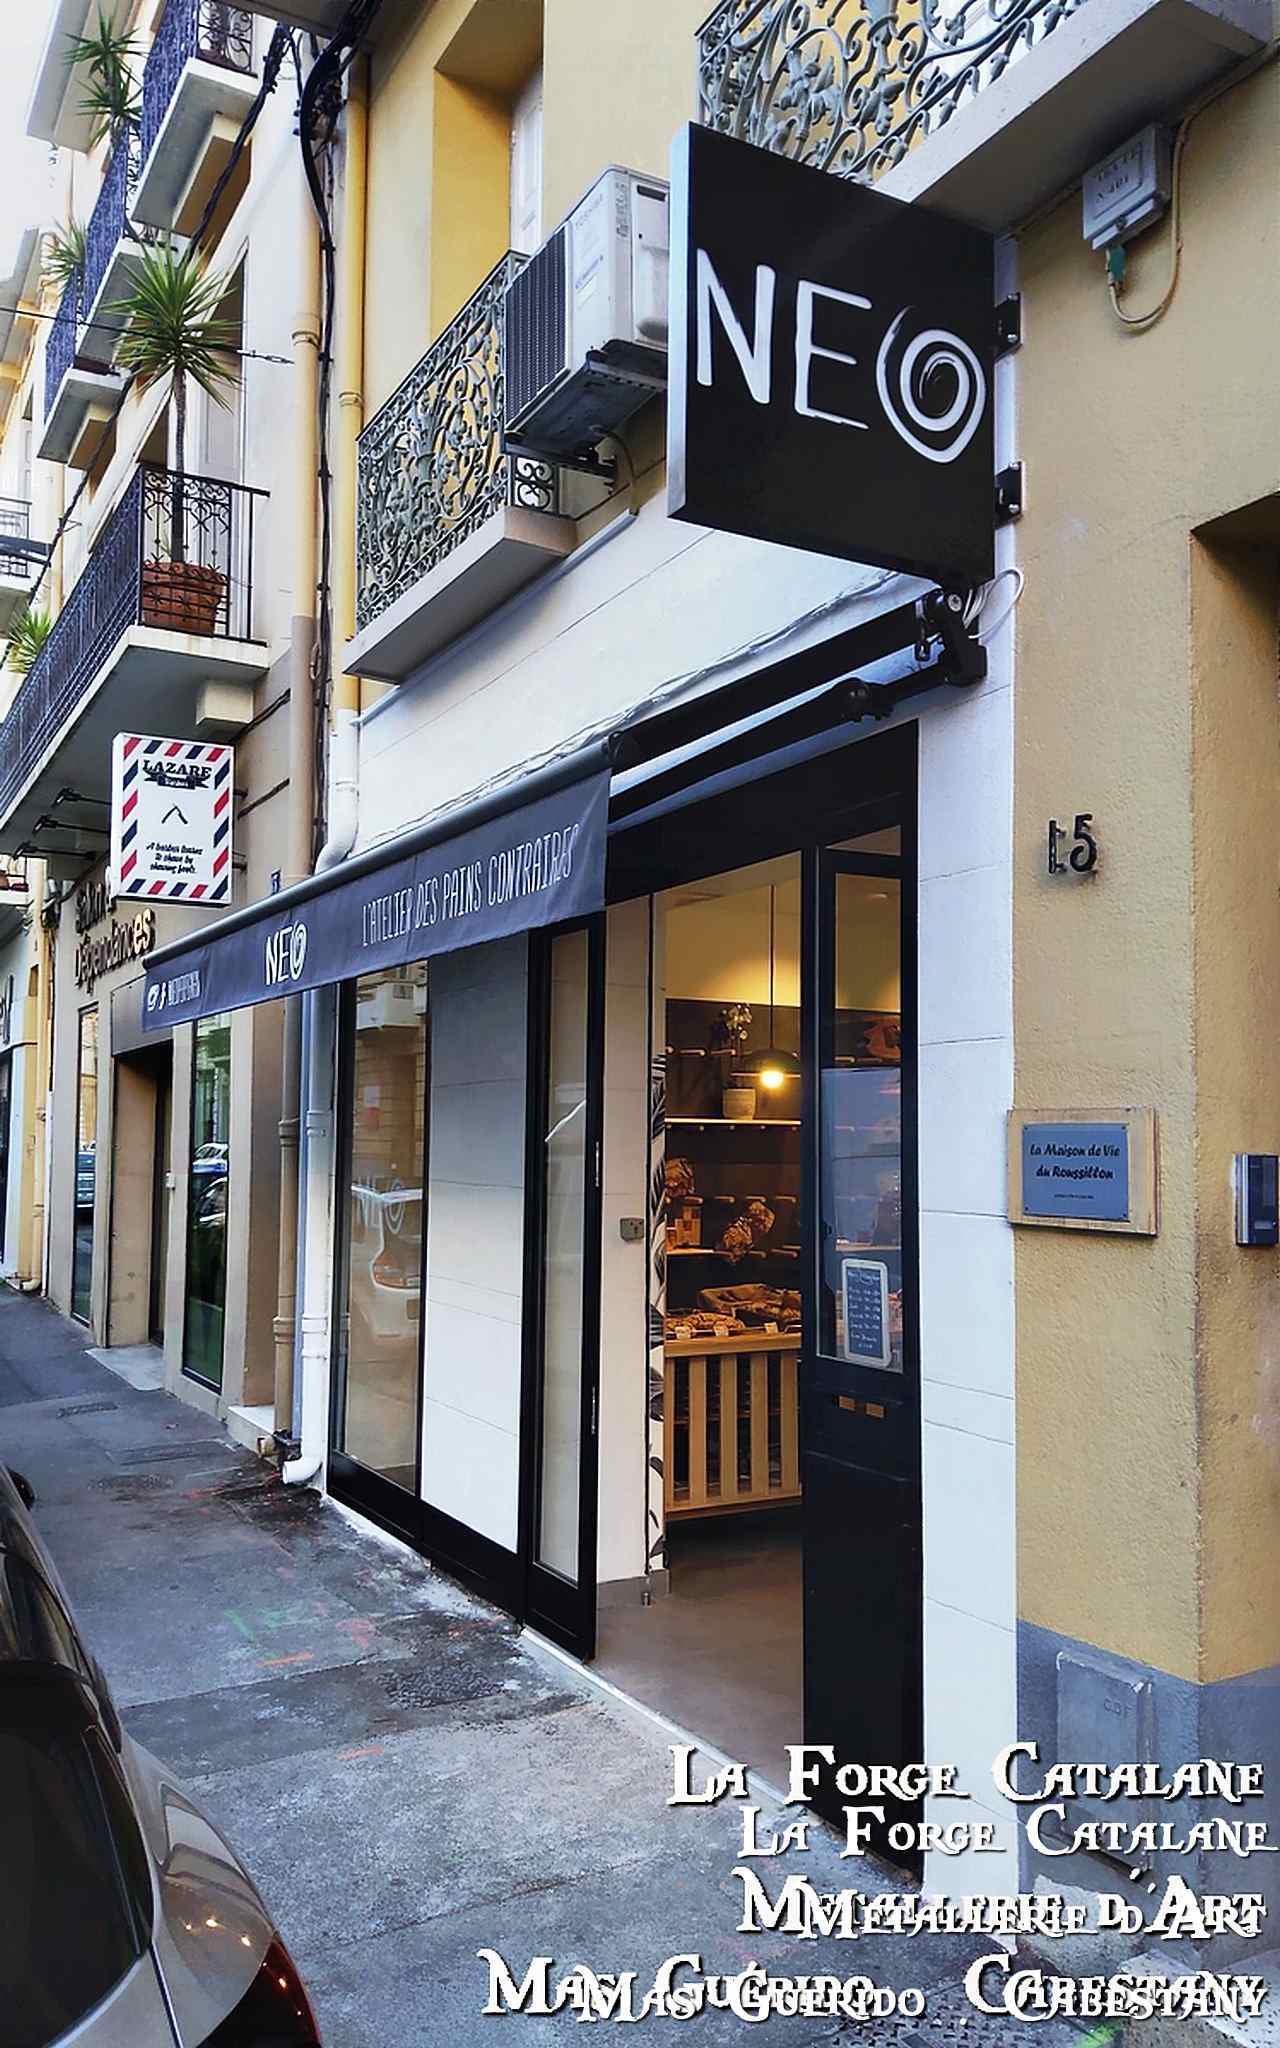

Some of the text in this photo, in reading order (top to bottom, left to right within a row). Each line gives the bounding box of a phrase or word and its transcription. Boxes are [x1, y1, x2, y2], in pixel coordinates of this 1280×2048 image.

[695, 247, 986, 464] NEO
[142, 759, 212, 778] LAZARE
[1048, 813, 1097, 873] 15
[414, 876, 439, 929] DES
[442, 860, 482, 920] PAINS
[487, 822, 581, 906] CONTRAIRES
[265, 919, 308, 986] NEO
[1030, 1143, 1120, 1157] La Maison de Vie
[1036, 1164, 1114, 1180] du Roussillon
